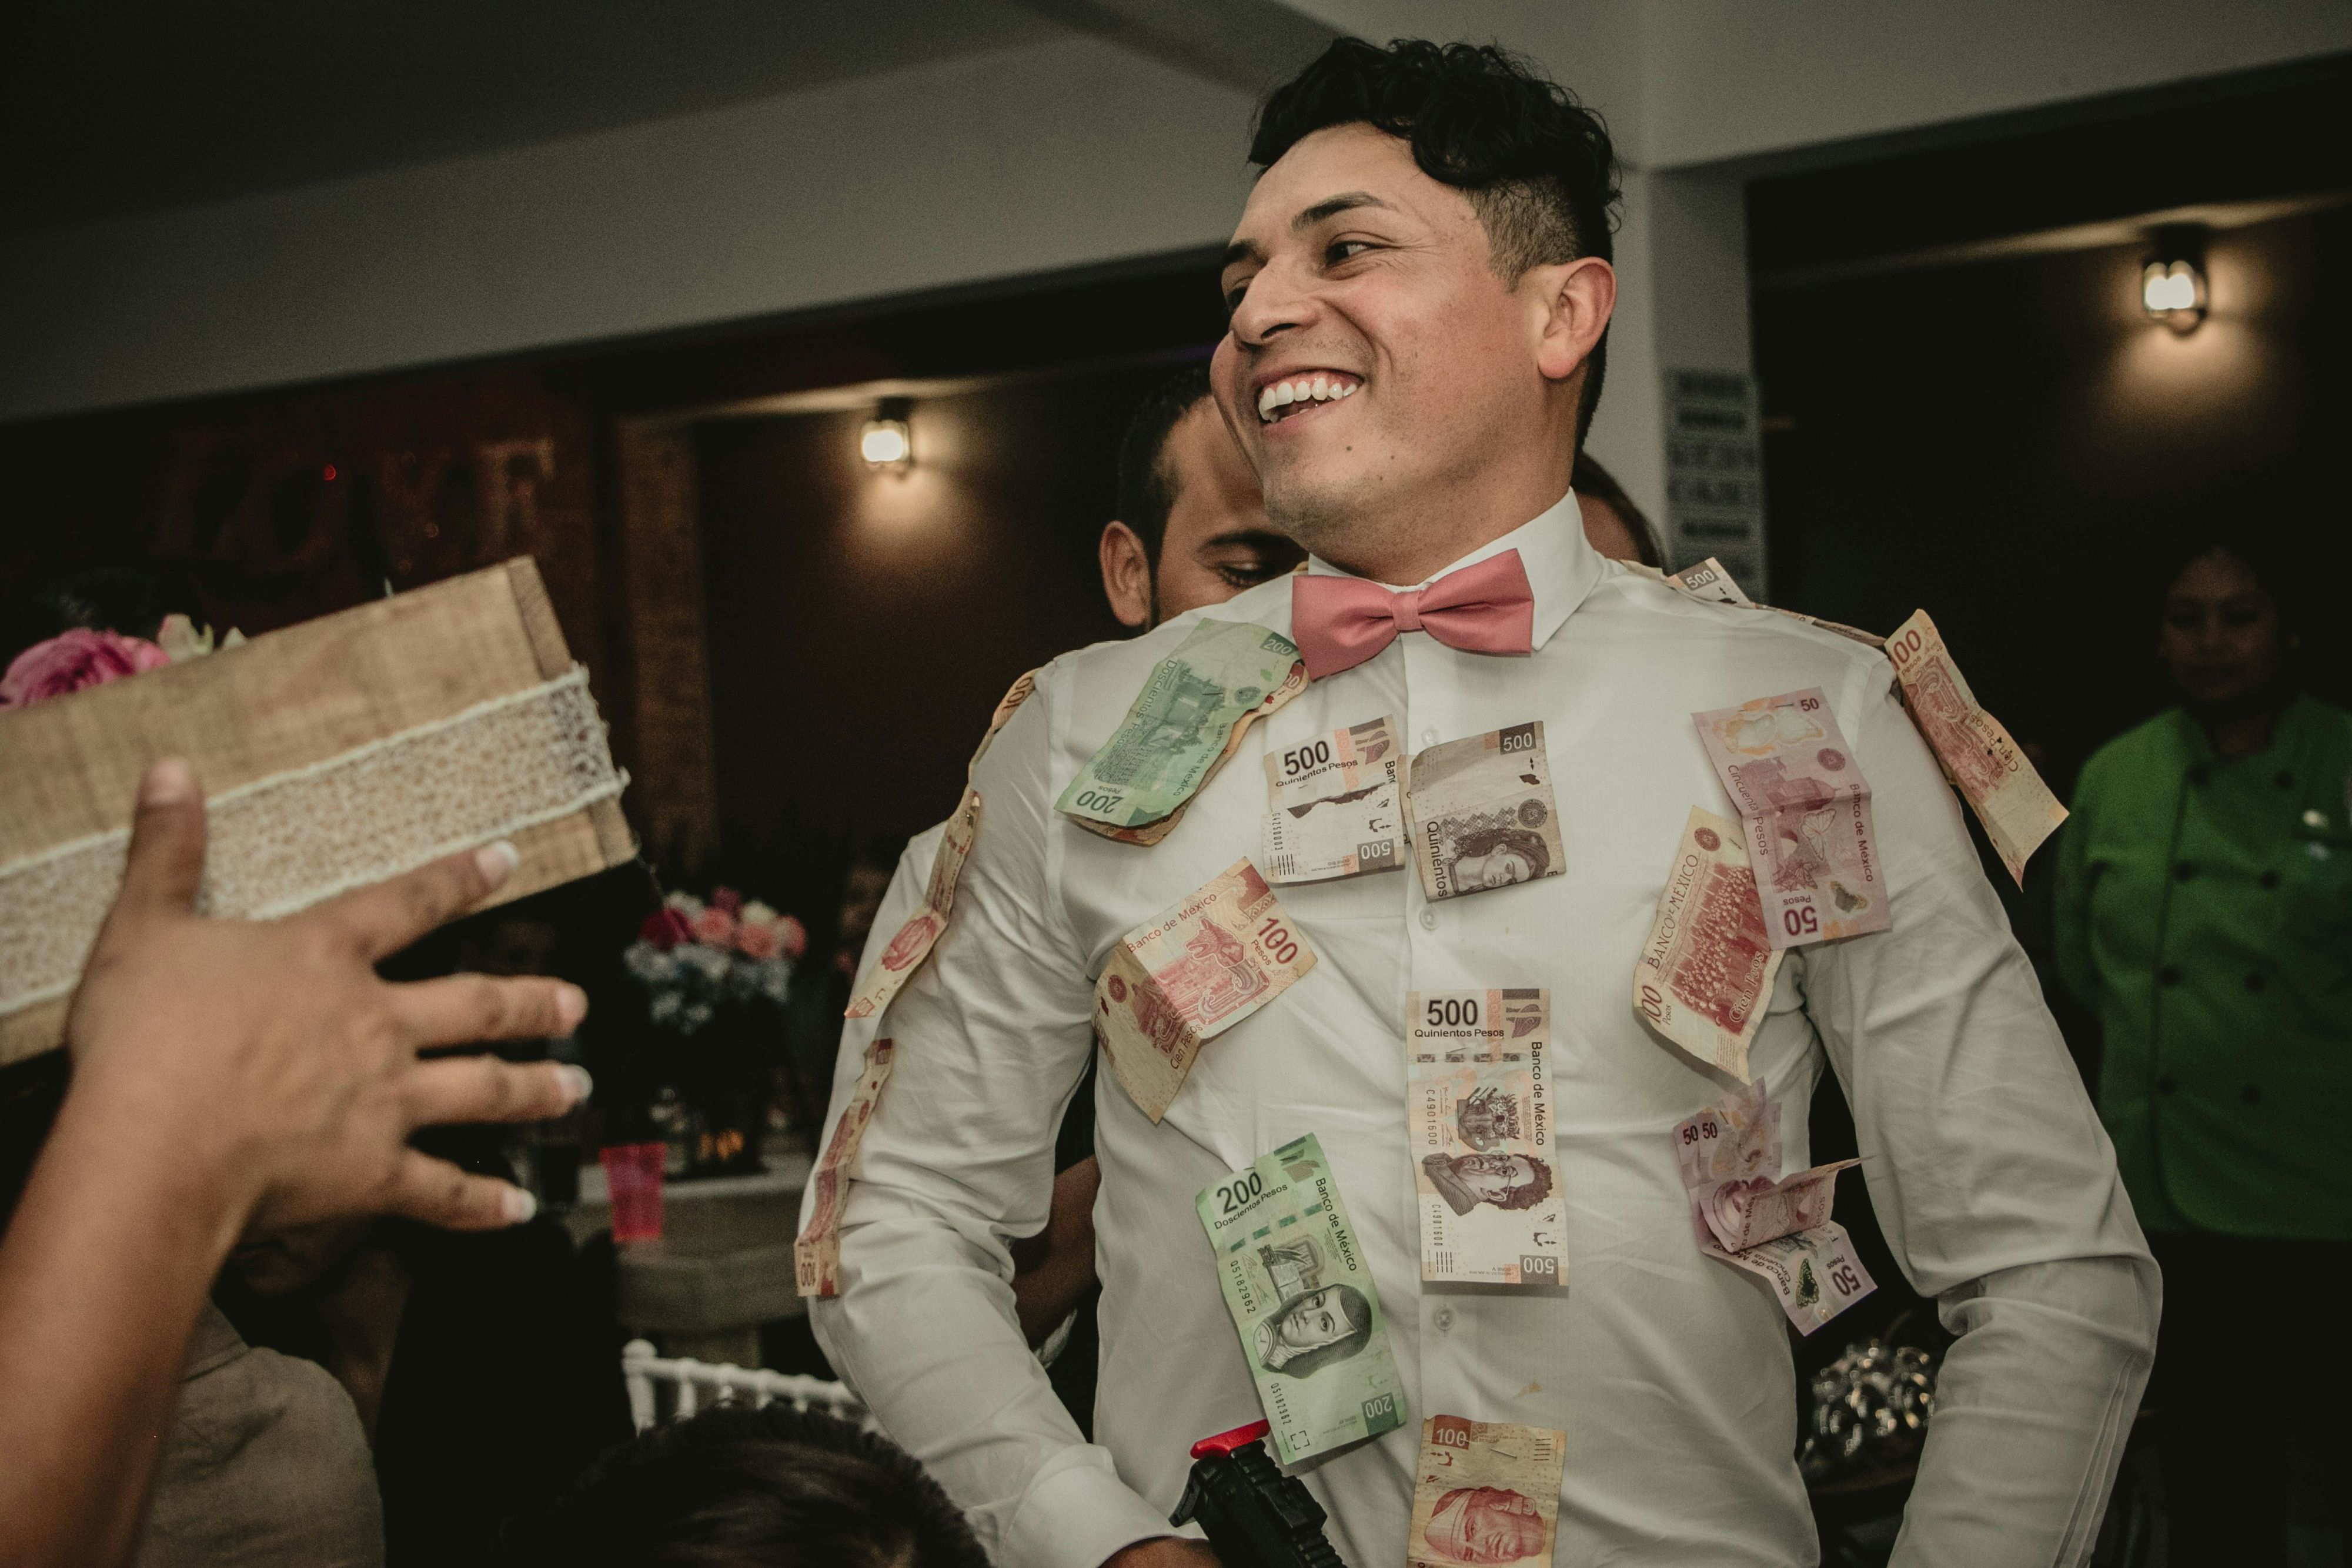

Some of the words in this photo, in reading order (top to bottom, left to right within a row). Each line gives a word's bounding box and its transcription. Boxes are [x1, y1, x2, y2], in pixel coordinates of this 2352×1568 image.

[1686, 569, 1715, 589] 500
[1264, 638, 1292, 654] 200
[1902, 656, 1922, 677] Pesos
[1136, 660, 1178, 718] Doscientos
[1800, 697, 1819, 711] 50
[1503, 733, 1533, 753] 500
[1197, 753, 1209, 764] de
[1284, 740, 1330, 775] 500
[1275, 766, 1327, 787] Quinientos
[1328, 760, 1358, 770] Pesos
[1077, 791, 1124, 814] 200
[1098, 785, 1121, 794] Pesos
[1849, 784, 1860, 818] Banco
[1728, 765, 1758, 811] Cincuenta
[1752, 816, 1769, 856] Pesos
[1854, 821, 1863, 836] de
[1361, 842, 1391, 860] 500
[1426, 821, 1447, 897] Quinientos
[1857, 839, 1874, 882] México
[1783, 894, 1812, 905] Pesos
[1783, 906, 1818, 937] 50
[1127, 928, 1162, 954] Banco
[1163, 918, 1178, 932] de
[1257, 917, 1298, 964] 100
[1648, 917, 1676, 969] BANCO
[1251, 940, 1272, 966] Pesos
[1426, 999, 1479, 1027] 500
[1641, 985, 1662, 1024] 100
[1662, 1004, 1672, 1026] Pesos
[1729, 988, 1754, 1023] Cien
[1414, 1029, 1472, 1037] Quinientos
[1474, 1028, 1504, 1037] Pesos
[1170, 1046, 1186, 1069] Cien
[1181, 1024, 1203, 1048] Pesos
[1531, 1041, 1543, 1080] Banco
[1533, 1084, 1544, 1098] de
[1426, 1089, 1438, 1145] C4901600
[1534, 1103, 1545, 1145] México
[1702, 1122, 1718, 1139] 50
[1683, 1125, 1699, 1145] 50
[1214, 1199, 1261, 1229] Doscientos
[1261, 1183, 1288, 1202] Pesos
[1217, 1171, 1262, 1215] 200
[1315, 1177, 1333, 1212] Banco
[1328, 1212, 1339, 1228] de
[1335, 1230, 1357, 1272] México
[1432, 1204, 1443, 1246] C4901600
[1524, 1257, 1555, 1274] 500
[1751, 1259, 1765, 1268] de
[1826, 1254, 1845, 1269] Pesos
[1766, 1264, 1790, 1296] Banco
[1832, 1265, 1862, 1297] 50
[1365, 1395, 1393, 1419] 200
[1436, 1428, 1468, 1446] 100
